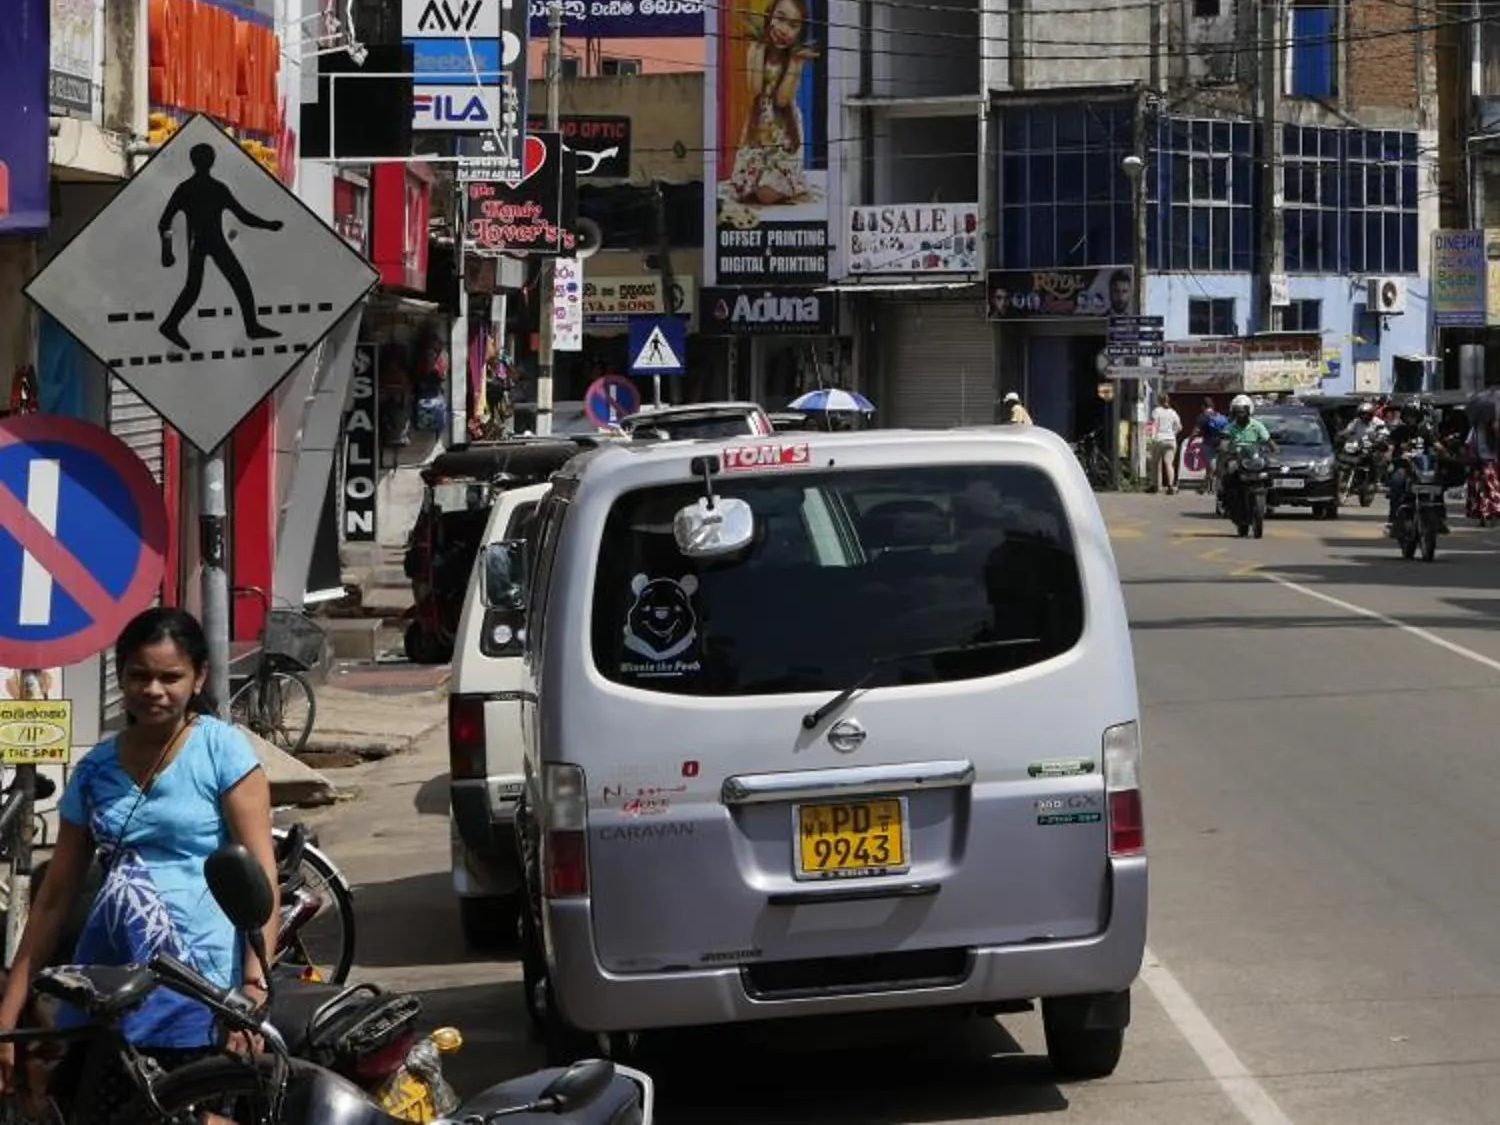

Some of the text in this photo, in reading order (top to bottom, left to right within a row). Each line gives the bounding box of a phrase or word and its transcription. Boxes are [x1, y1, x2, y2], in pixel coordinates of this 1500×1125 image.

[414, 95, 489, 121] FILA
[881, 208, 947, 233] SALE
[721, 230, 825, 246] OFFSET PRINTING
[720, 256, 825, 272] DIGITAL PRINTING
[347, 376, 375, 533] SALON
[33, 748, 65, 758] SPOT
[601, 821, 695, 841] CARAVAN
[832, 805, 871, 834] PD
[815, 835, 890, 868] 9943
